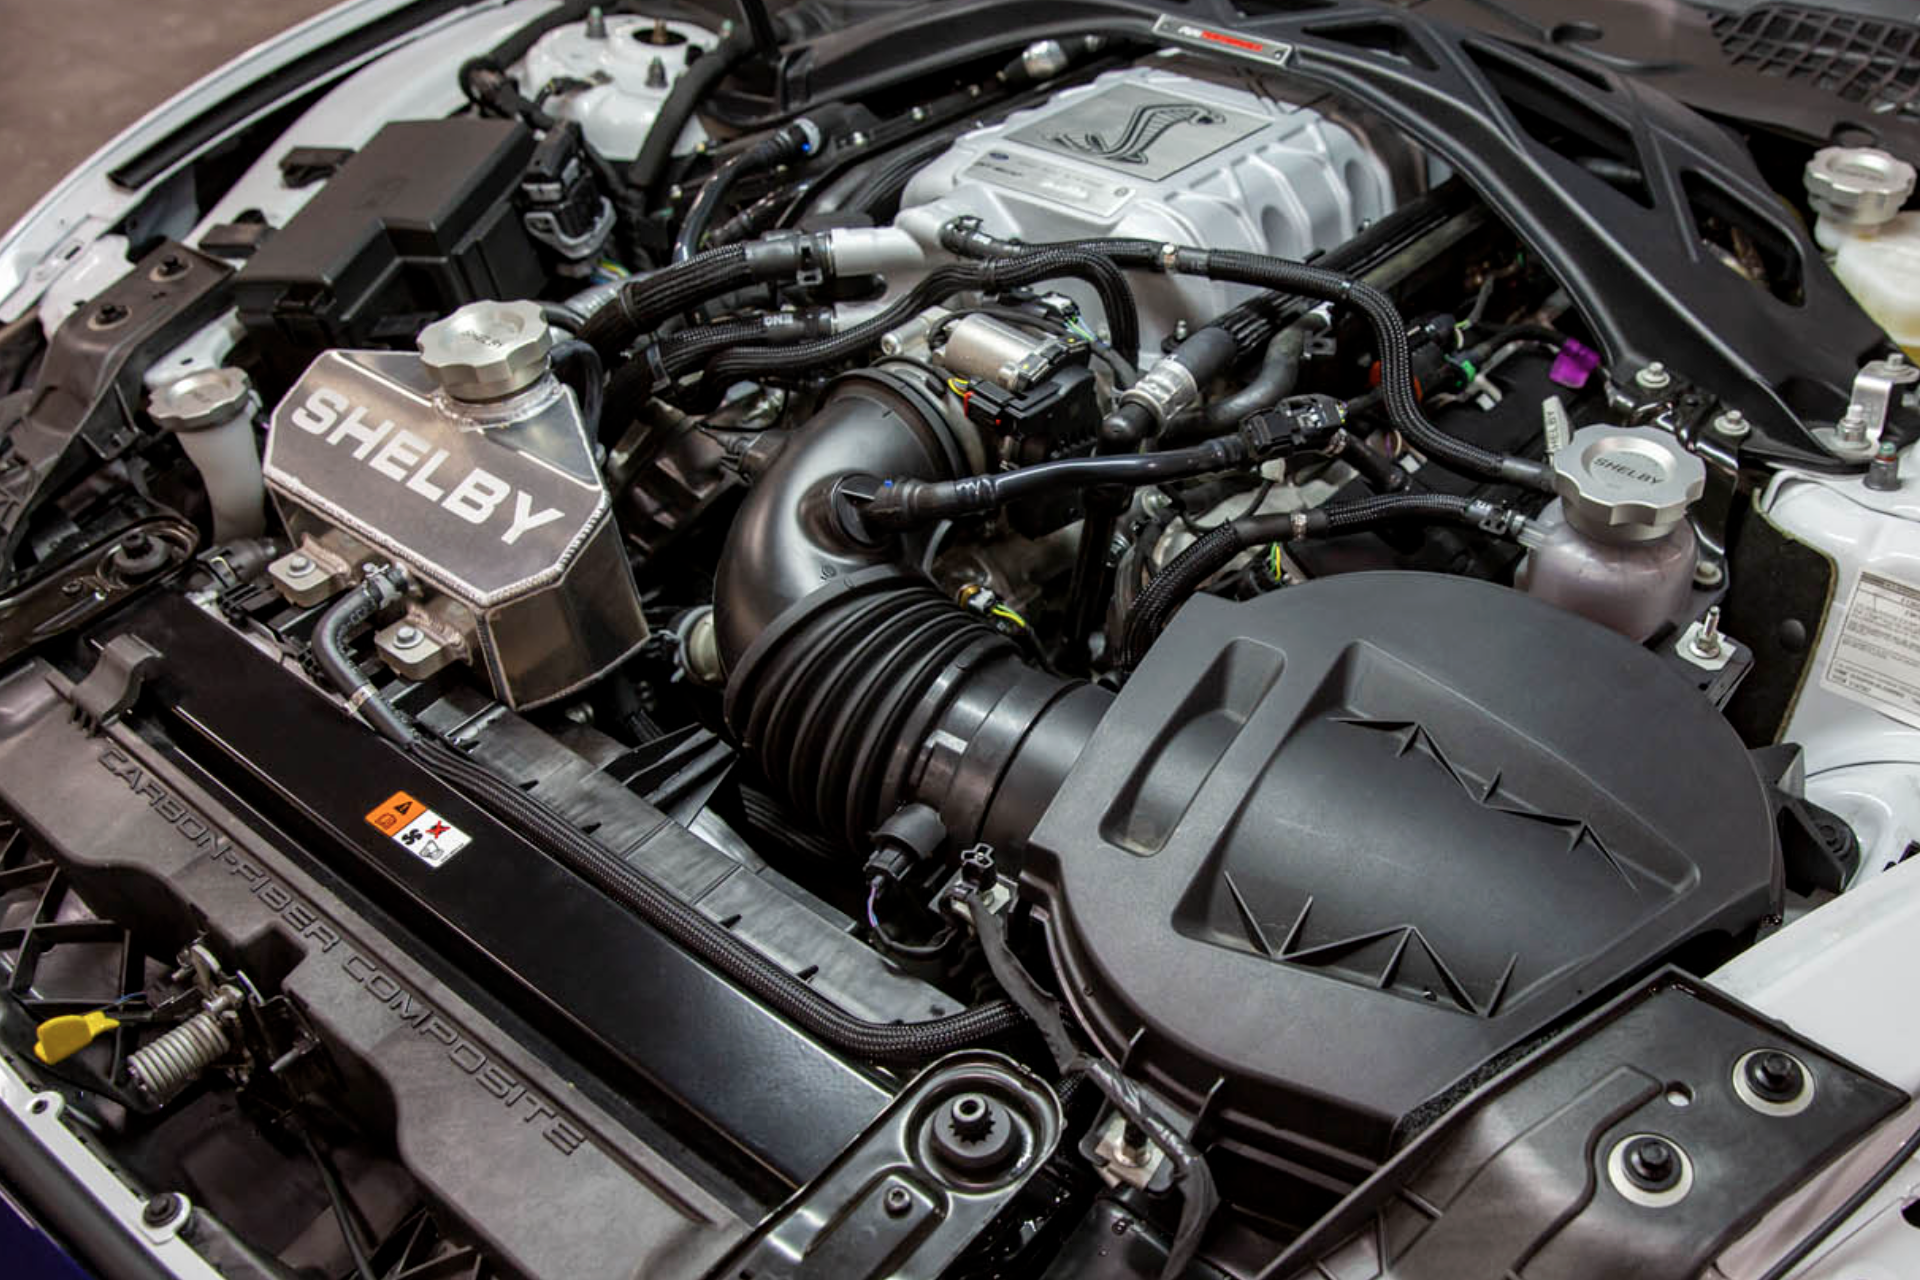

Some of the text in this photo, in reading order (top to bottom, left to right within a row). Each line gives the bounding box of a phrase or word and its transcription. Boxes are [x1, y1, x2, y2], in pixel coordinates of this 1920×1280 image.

[291, 387, 565, 546] SHELBY
[1594, 457, 1665, 485] SHELBY
[97, 747, 588, 1157] CARBON-FIBER COMPOSITE
